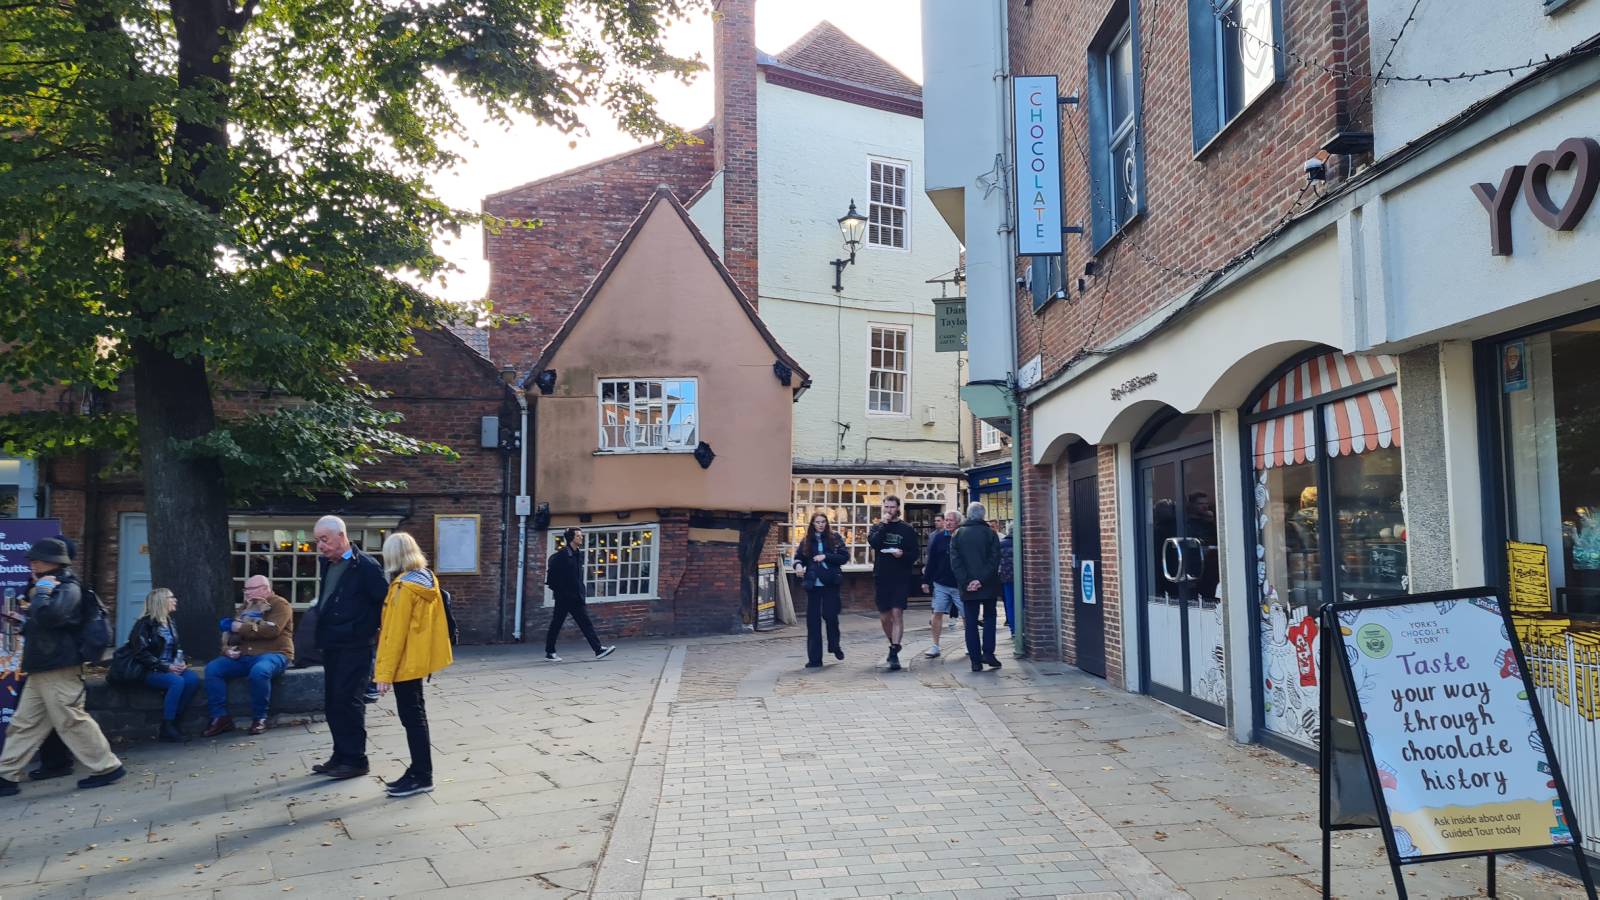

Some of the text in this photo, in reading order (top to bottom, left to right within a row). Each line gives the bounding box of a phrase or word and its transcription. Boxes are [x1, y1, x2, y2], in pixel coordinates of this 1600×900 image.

[1030, 92, 1045, 238] CHOCOLATE
[1400, 627, 1449, 638] CHOCOLATE
[1409, 620, 1438, 629] YORK'S
[1414, 636, 1439, 645] STORY
[1396, 651, 1470, 675] Taste
[1391, 682, 1491, 712] your way
[1403, 704, 1495, 736] through
[1402, 735, 1512, 762] chocolate
[1421, 768, 1508, 795] history
[1434, 811, 1521, 826] Ask inside about our
[1441, 824, 1521, 839] Guided Tour today
